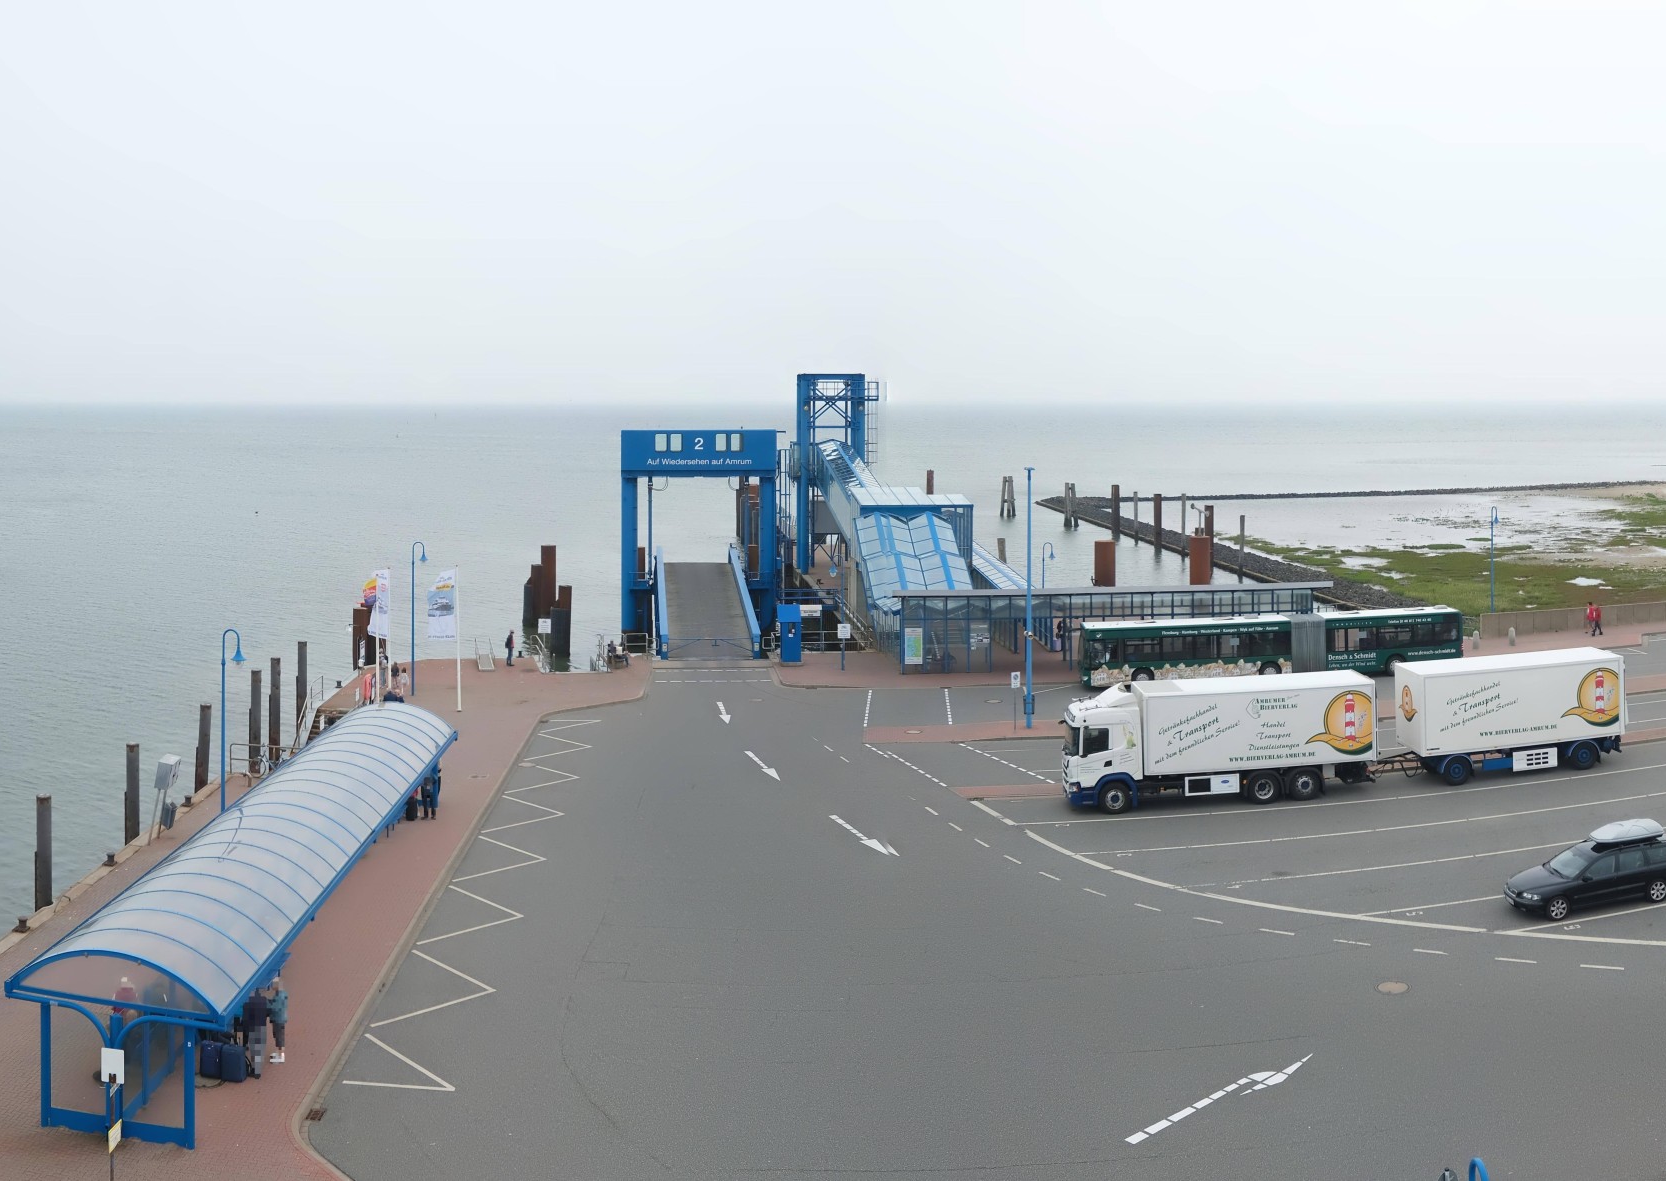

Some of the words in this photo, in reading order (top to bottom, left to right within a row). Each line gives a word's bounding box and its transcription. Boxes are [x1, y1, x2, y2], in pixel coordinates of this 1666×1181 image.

[694, 437, 704, 450] 2
[1458, 693, 1501, 713] Transport
[1495, 698, 1519, 712] Service!
[1158, 703, 1218, 735] Getränkefachhandel
[1172, 716, 1220, 741] Transport
[1479, 724, 1557, 737] WWW.BIERVERLAG-AMRUM.DE
[1154, 757, 1164, 765] mit
[1165, 751, 1177, 759] dem
[1178, 733, 1214, 755] freundlichen
[1215, 720, 1241, 738] Service!
[1255, 732, 1291, 740] Transport
[1248, 743, 1300, 751] Dienstleistungen
[1229, 751, 1316, 762] WWW.BIERVERLAG-AMRUM.DE
